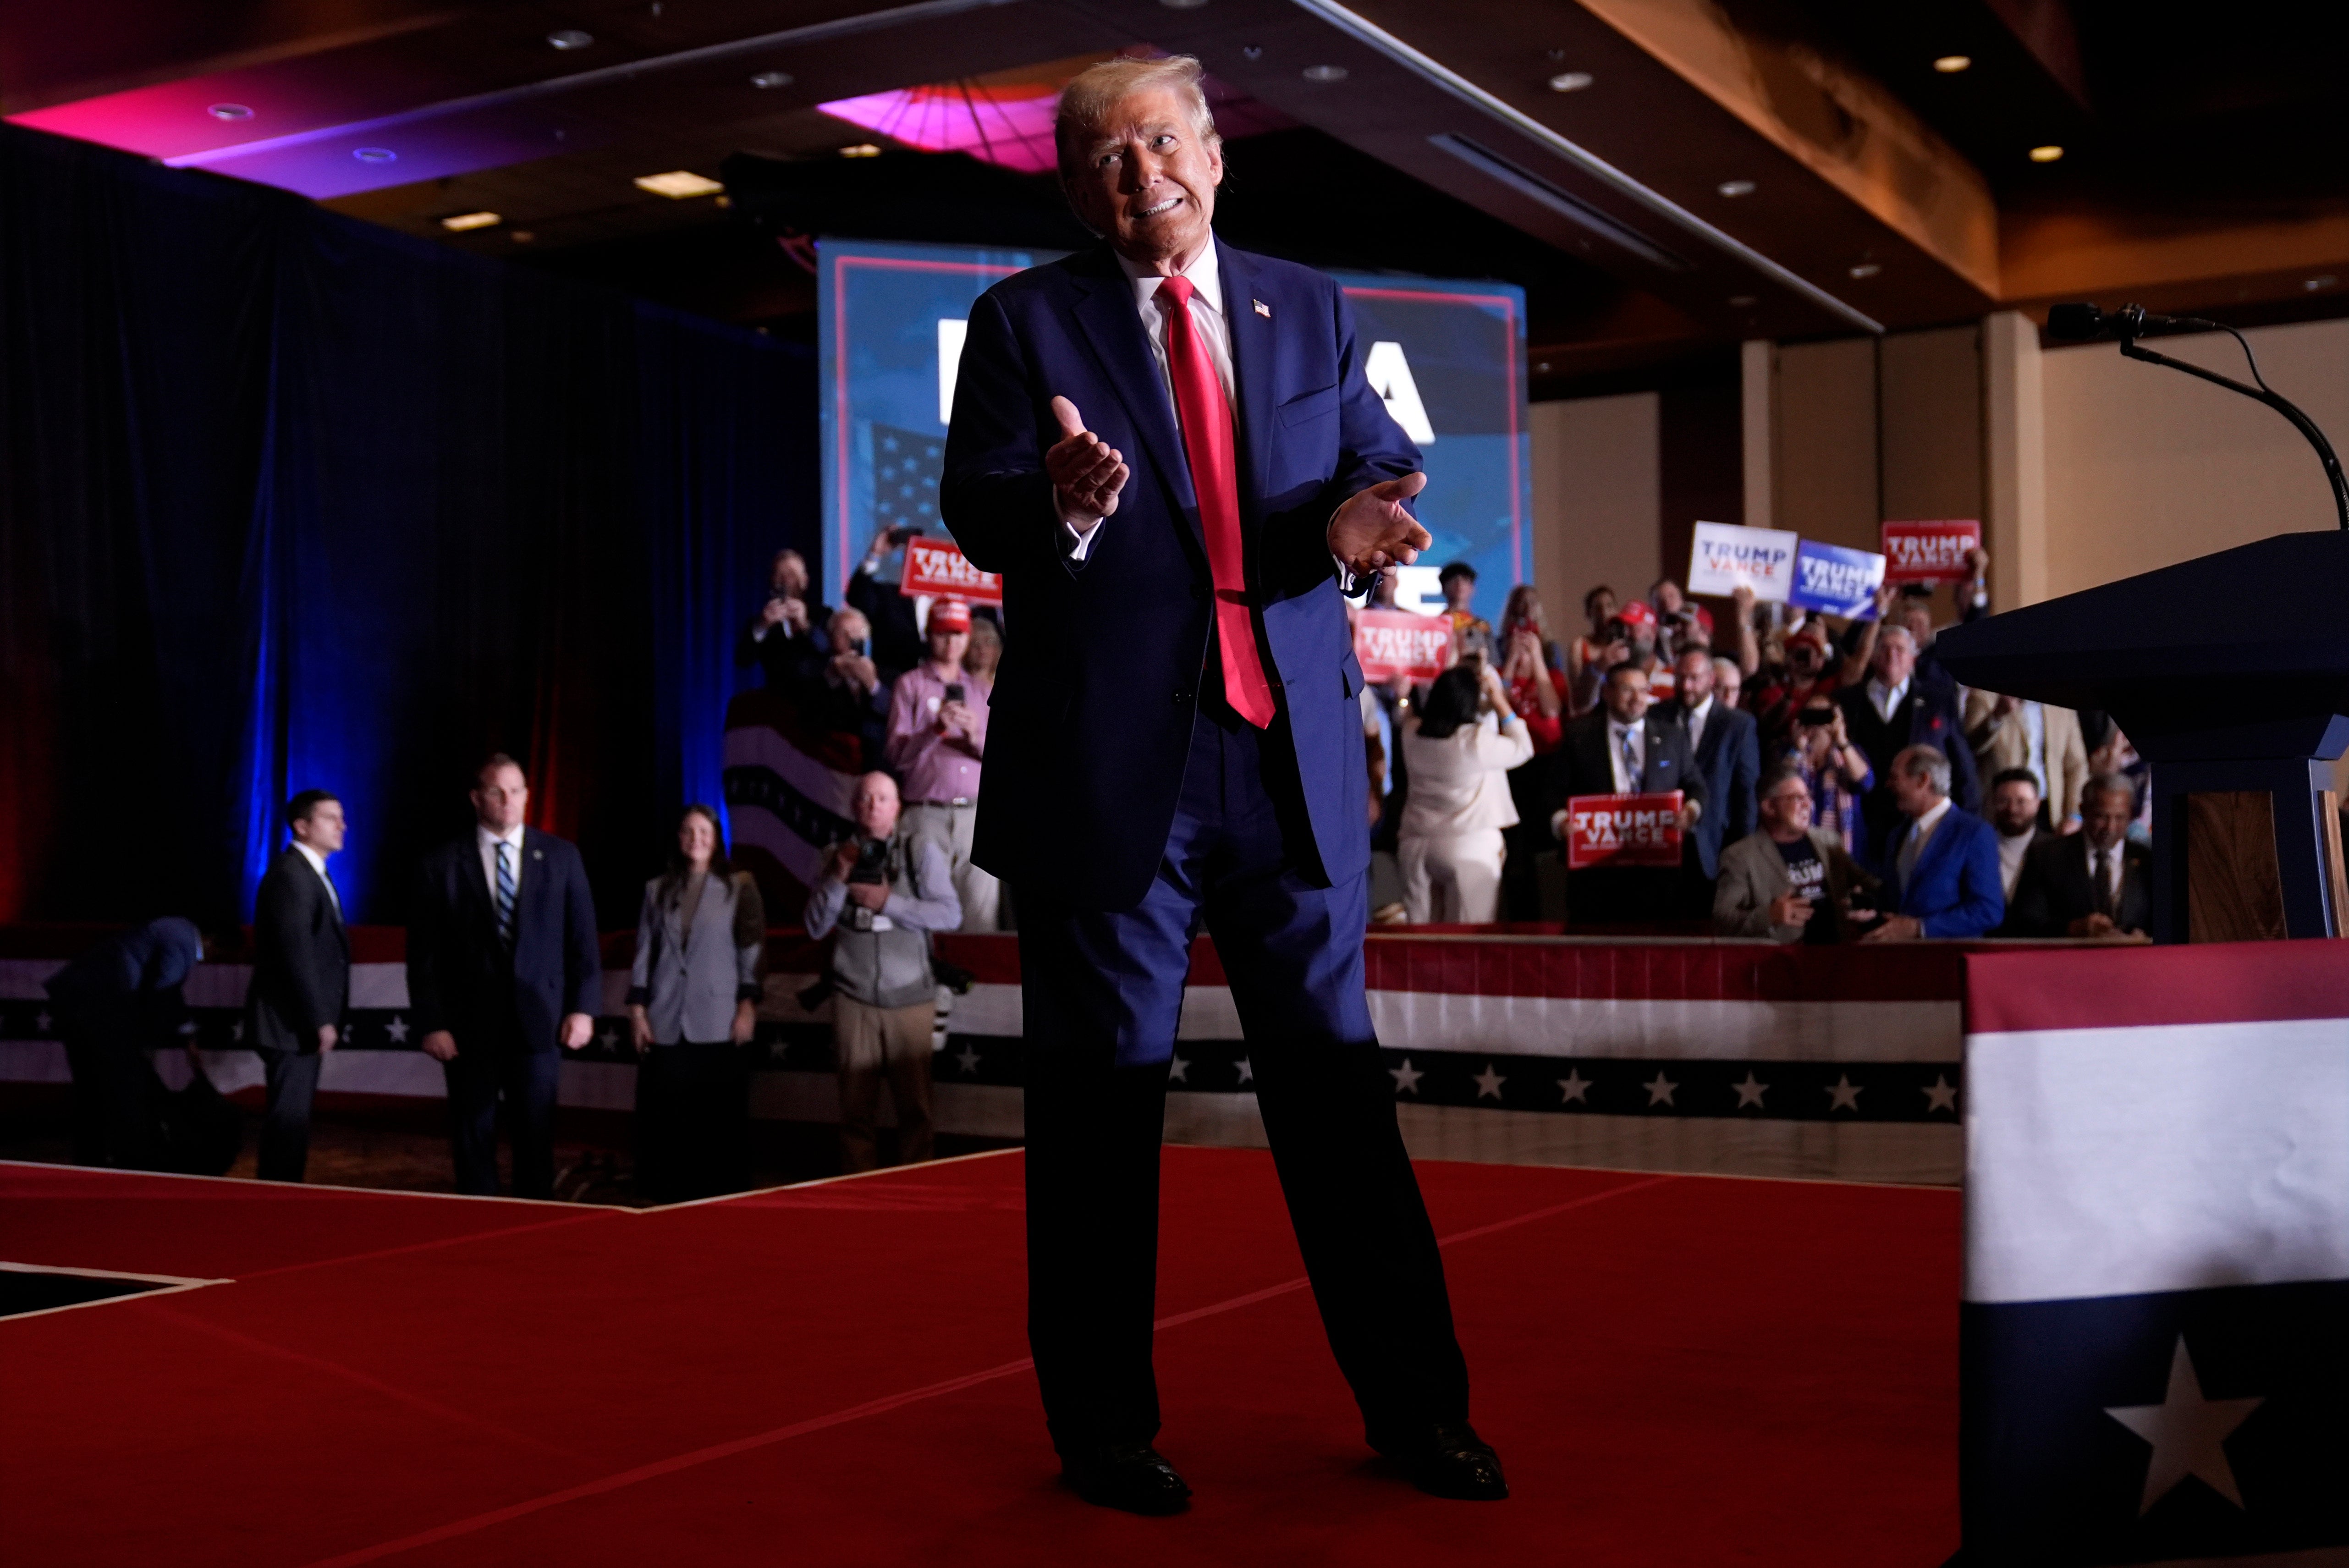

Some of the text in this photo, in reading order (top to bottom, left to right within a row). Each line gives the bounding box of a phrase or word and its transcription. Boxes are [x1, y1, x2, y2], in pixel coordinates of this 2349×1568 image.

[1702, 540, 1787, 563] TRUMP
[1887, 535, 1975, 553] TRUMP
[1711, 559, 1774, 576] VANCE
[1362, 627, 1447, 648] TRUMP
[1575, 809, 1674, 830] TRUMP
[1586, 825, 1664, 844] VANCE
